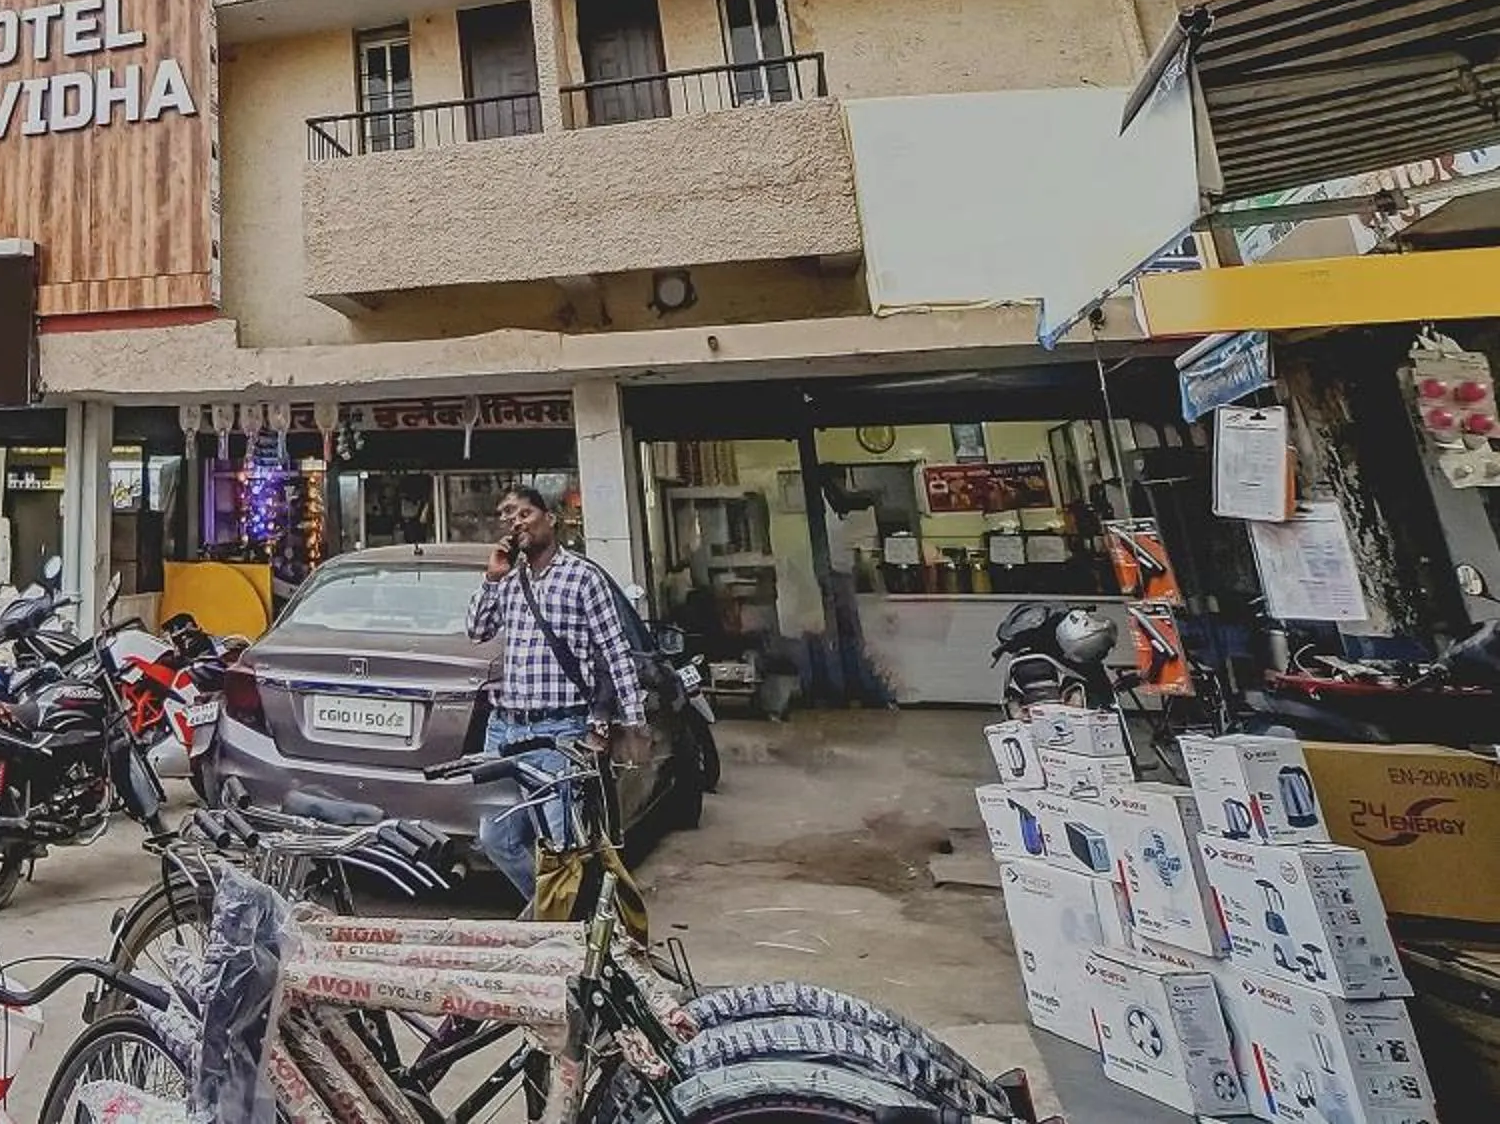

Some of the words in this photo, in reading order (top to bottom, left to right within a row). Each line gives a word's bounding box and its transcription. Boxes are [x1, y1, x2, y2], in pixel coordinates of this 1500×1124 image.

[1349, 799, 1389, 829] 24
[1389, 815, 1466, 836] ENERGY
[307, 975, 371, 999] AVON
